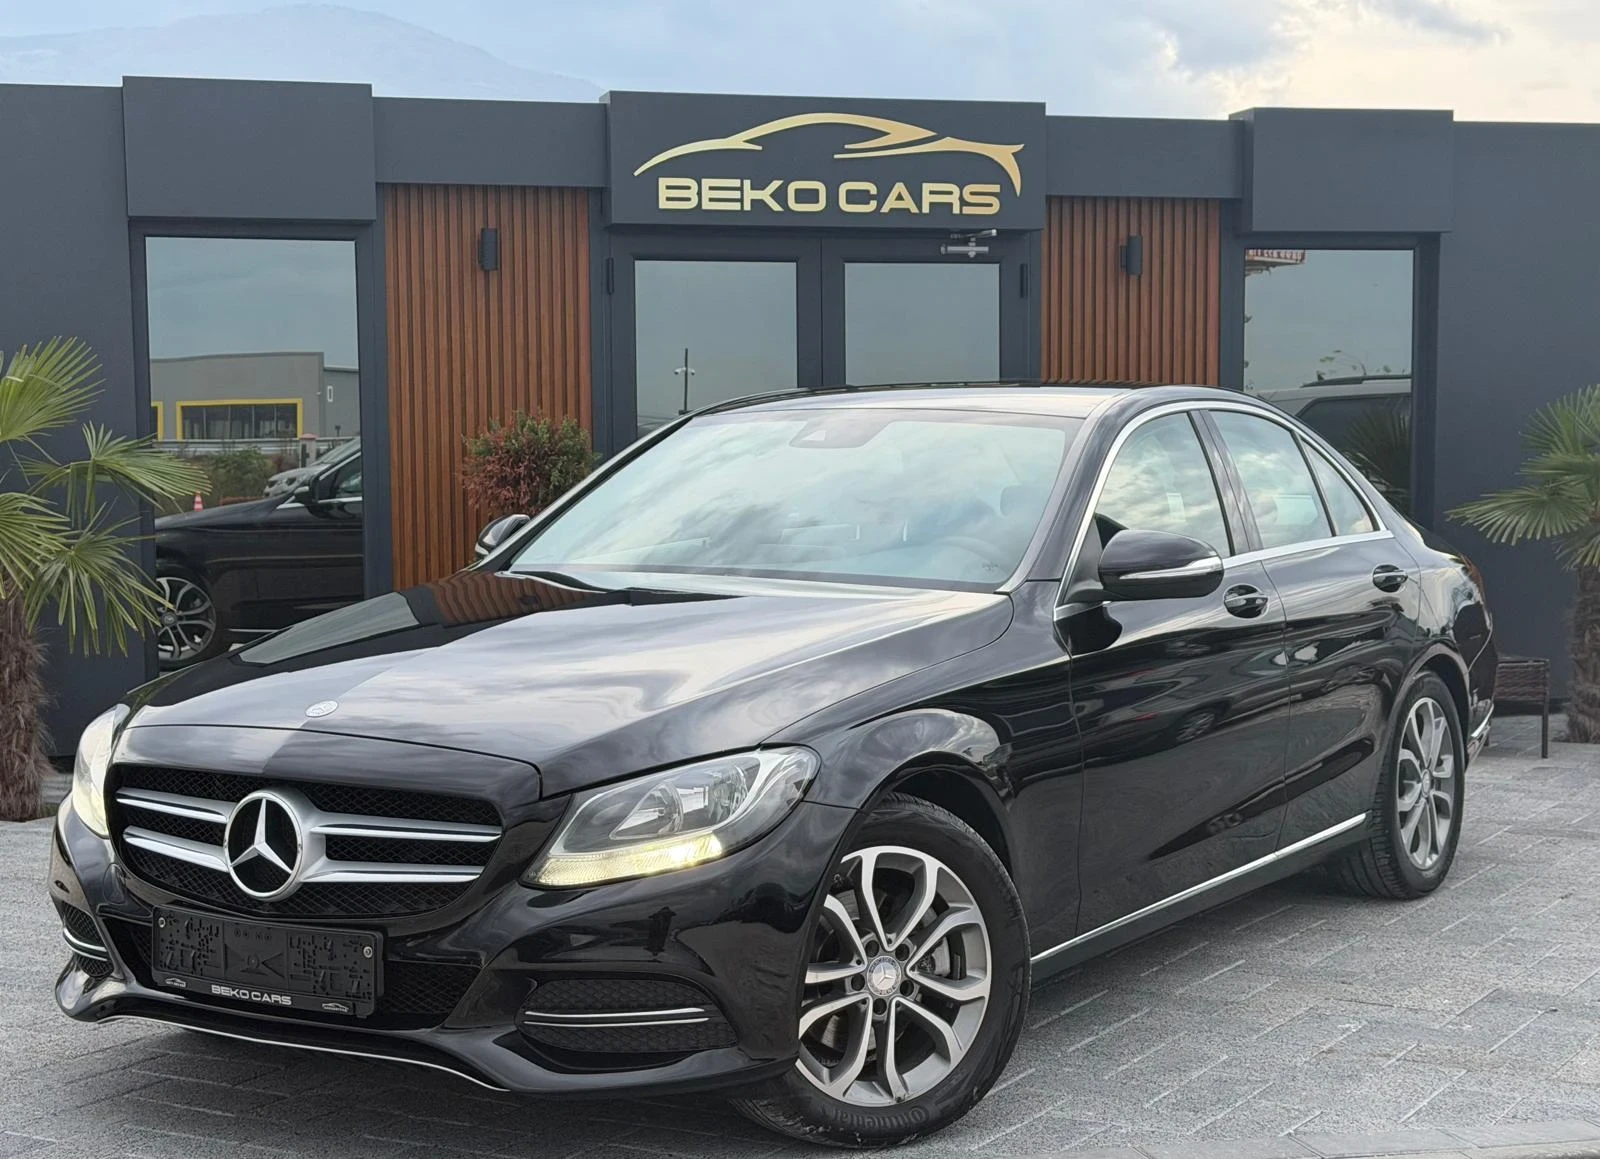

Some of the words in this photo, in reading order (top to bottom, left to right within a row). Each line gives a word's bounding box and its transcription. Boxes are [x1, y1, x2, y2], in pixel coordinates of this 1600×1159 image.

[658, 177, 827, 213] BEKO
[839, 181, 1001, 215] CARS
[211, 984, 249, 999] BEKO
[251, 991, 292, 1006] CARS
